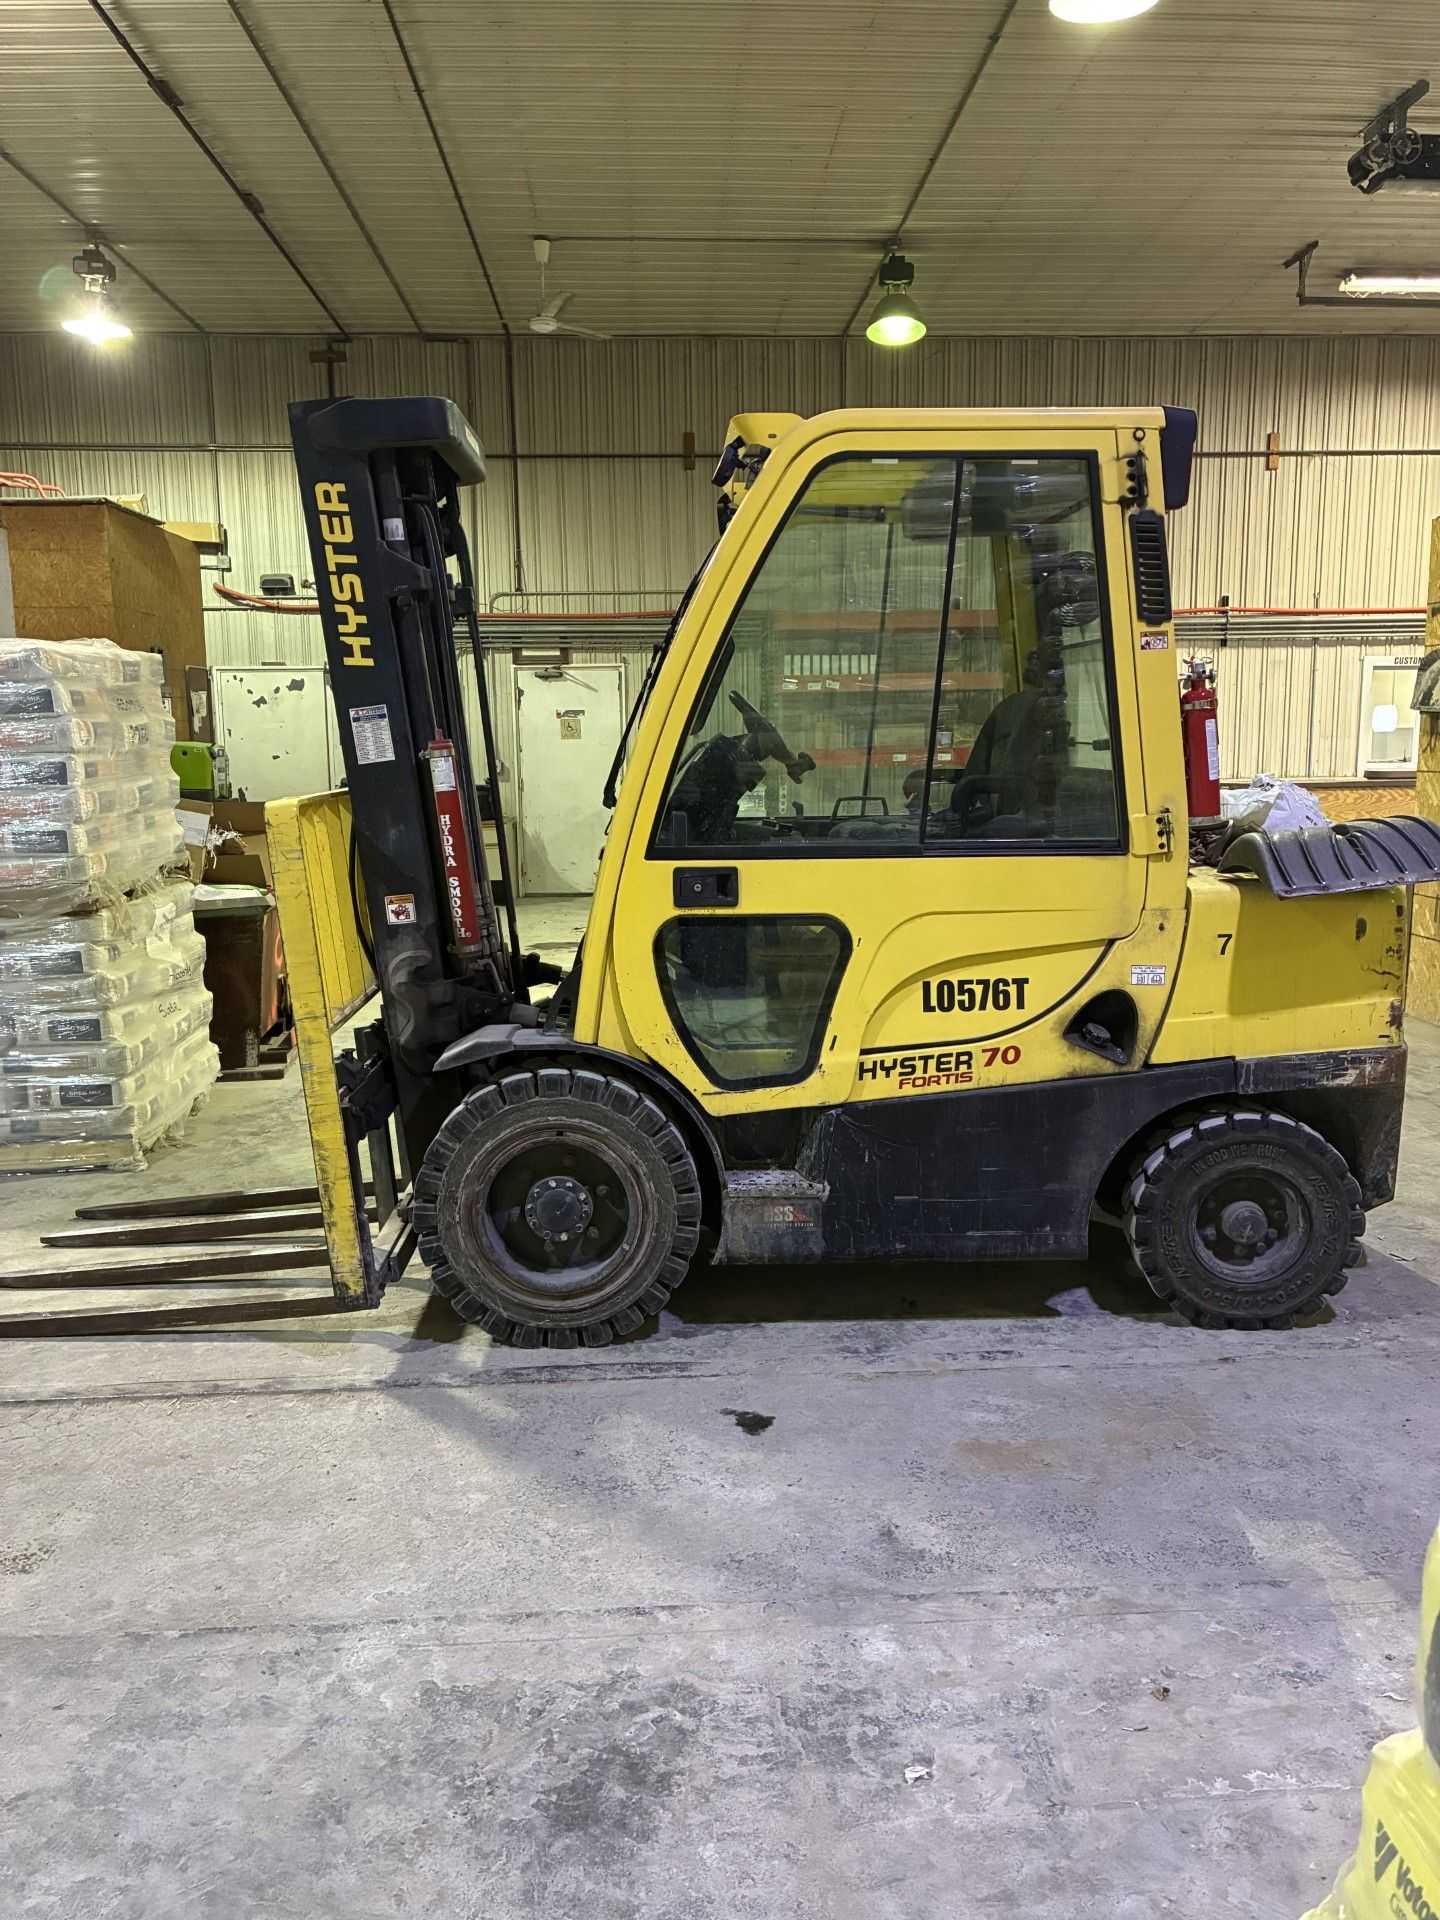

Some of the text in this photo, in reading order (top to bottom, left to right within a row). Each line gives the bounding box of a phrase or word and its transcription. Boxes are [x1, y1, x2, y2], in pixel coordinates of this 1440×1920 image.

[314, 481, 375, 667] HYSTER
[440, 814, 457, 867] HYDRA
[1216, 933, 1233, 955] 7
[858, 1045, 1021, 1081] HYSTER 70
[898, 1071, 973, 1090] FORTIS
